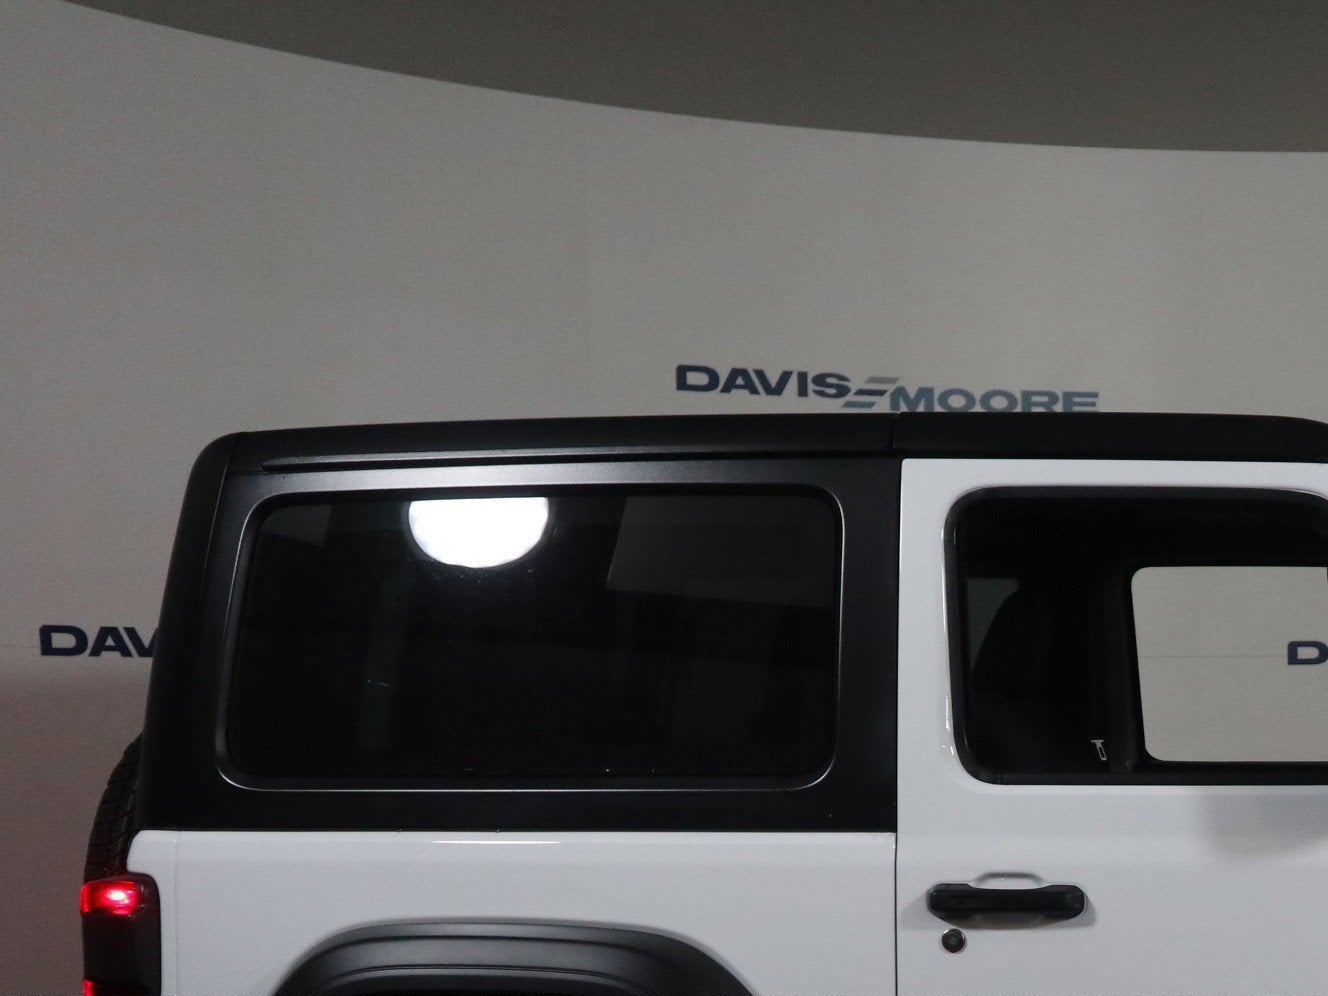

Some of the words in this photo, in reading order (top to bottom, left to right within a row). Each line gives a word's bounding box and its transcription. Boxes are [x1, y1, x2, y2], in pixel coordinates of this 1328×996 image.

[675, 364, 852, 399] DAVIS
[888, 385, 1100, 413] MOORE
[39, 624, 158, 658] DAV
